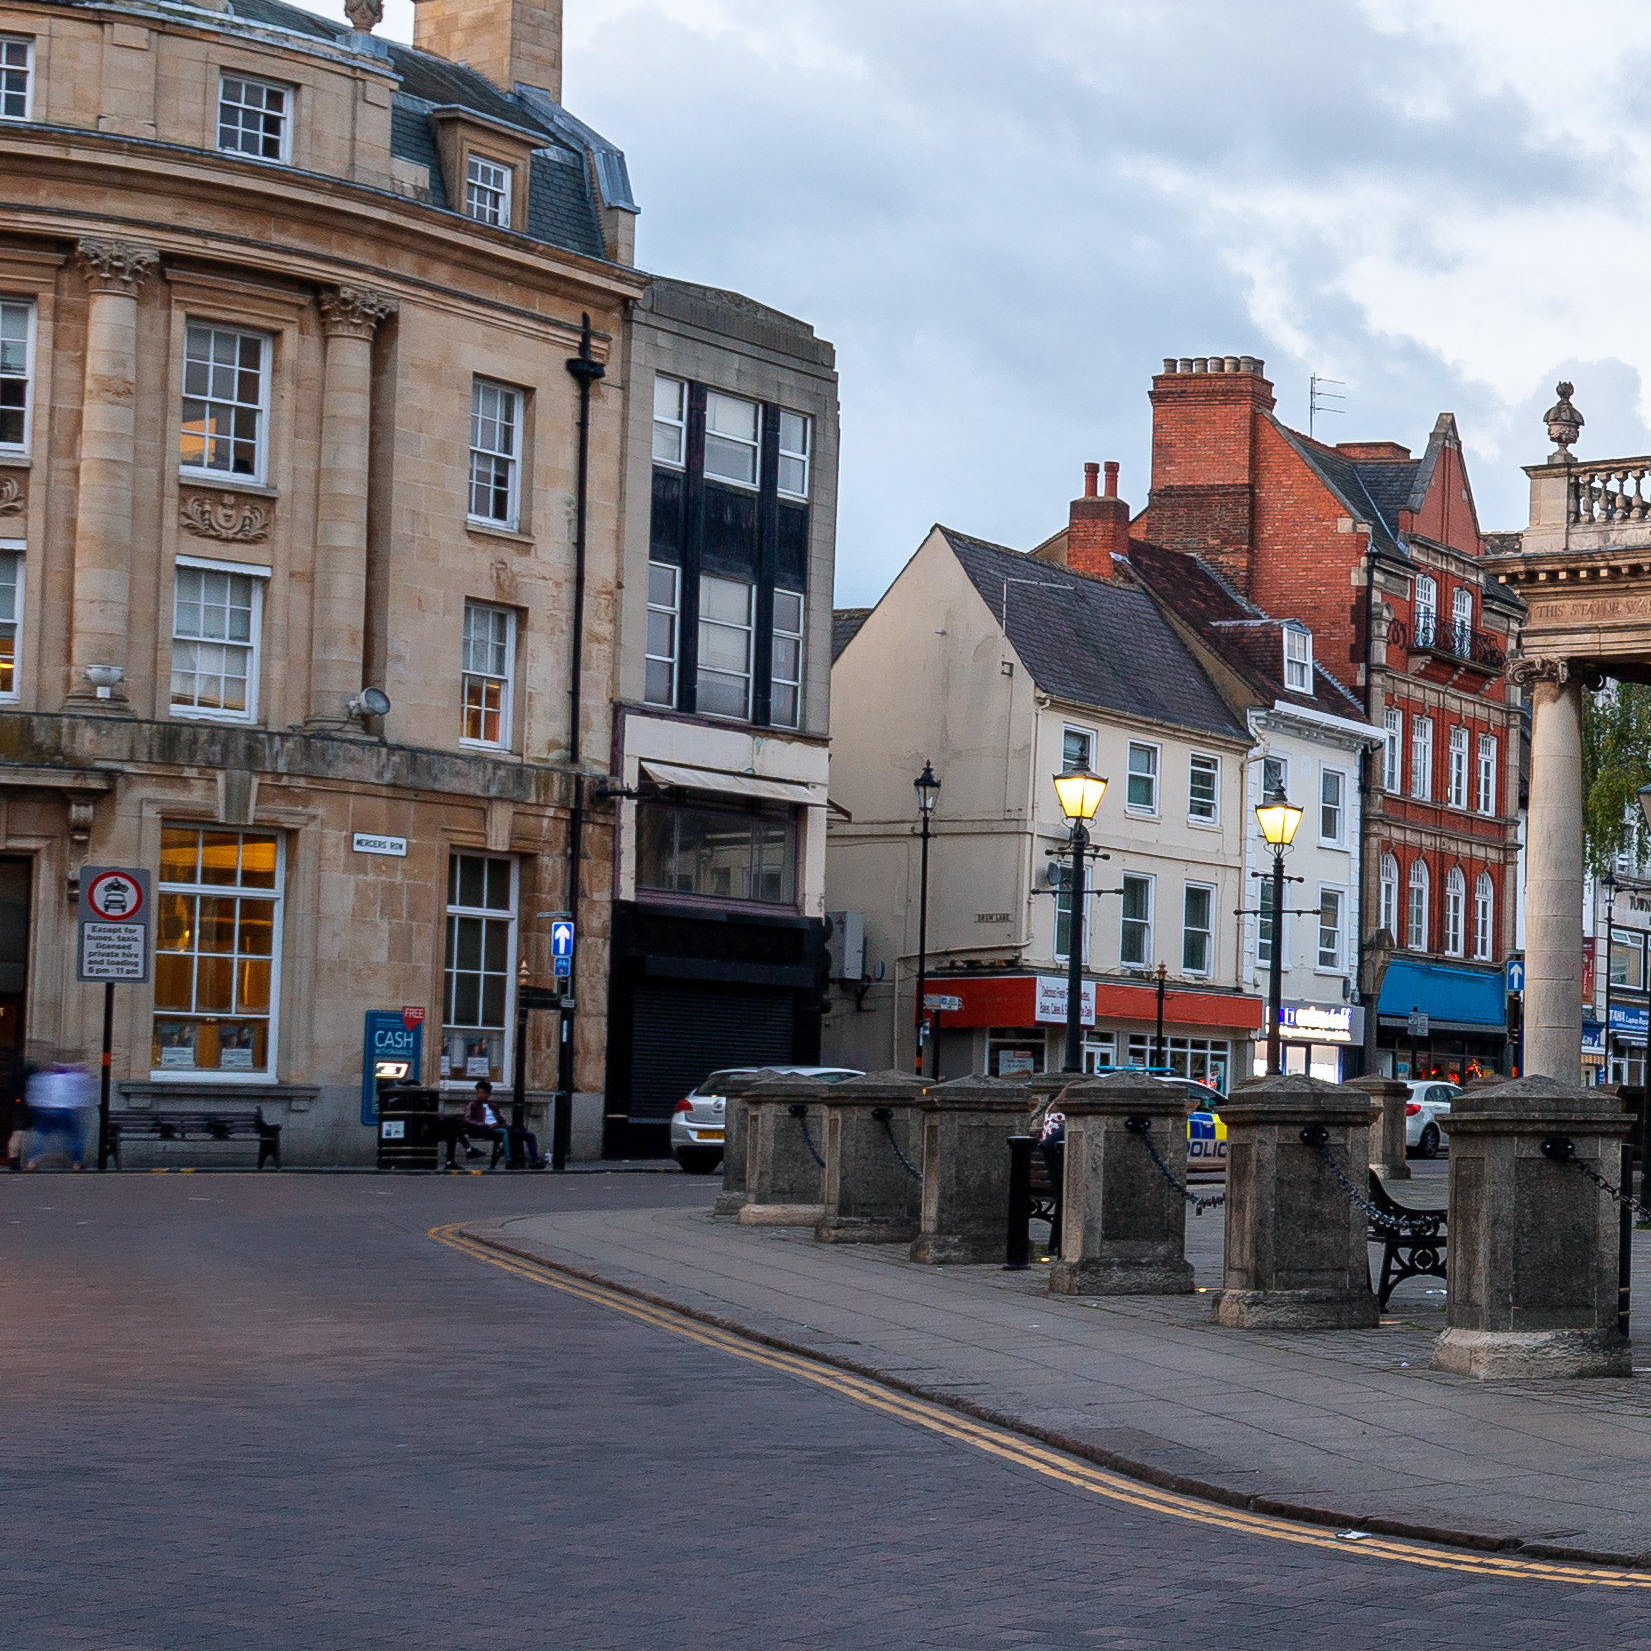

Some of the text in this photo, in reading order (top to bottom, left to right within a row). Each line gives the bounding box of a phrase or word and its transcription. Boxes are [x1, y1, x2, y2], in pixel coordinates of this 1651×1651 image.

[1536, 603, 1564, 619] THIS
[92, 925, 137, 935] Except for
[96, 942, 132, 950] licensed
[88, 951, 119, 959] private
[106, 959, 140, 968] loading
[404, 1008, 424, 1019] FREE
[374, 1030, 414, 1049] CASH
[1187, 1141, 1227, 1159] OLIC
